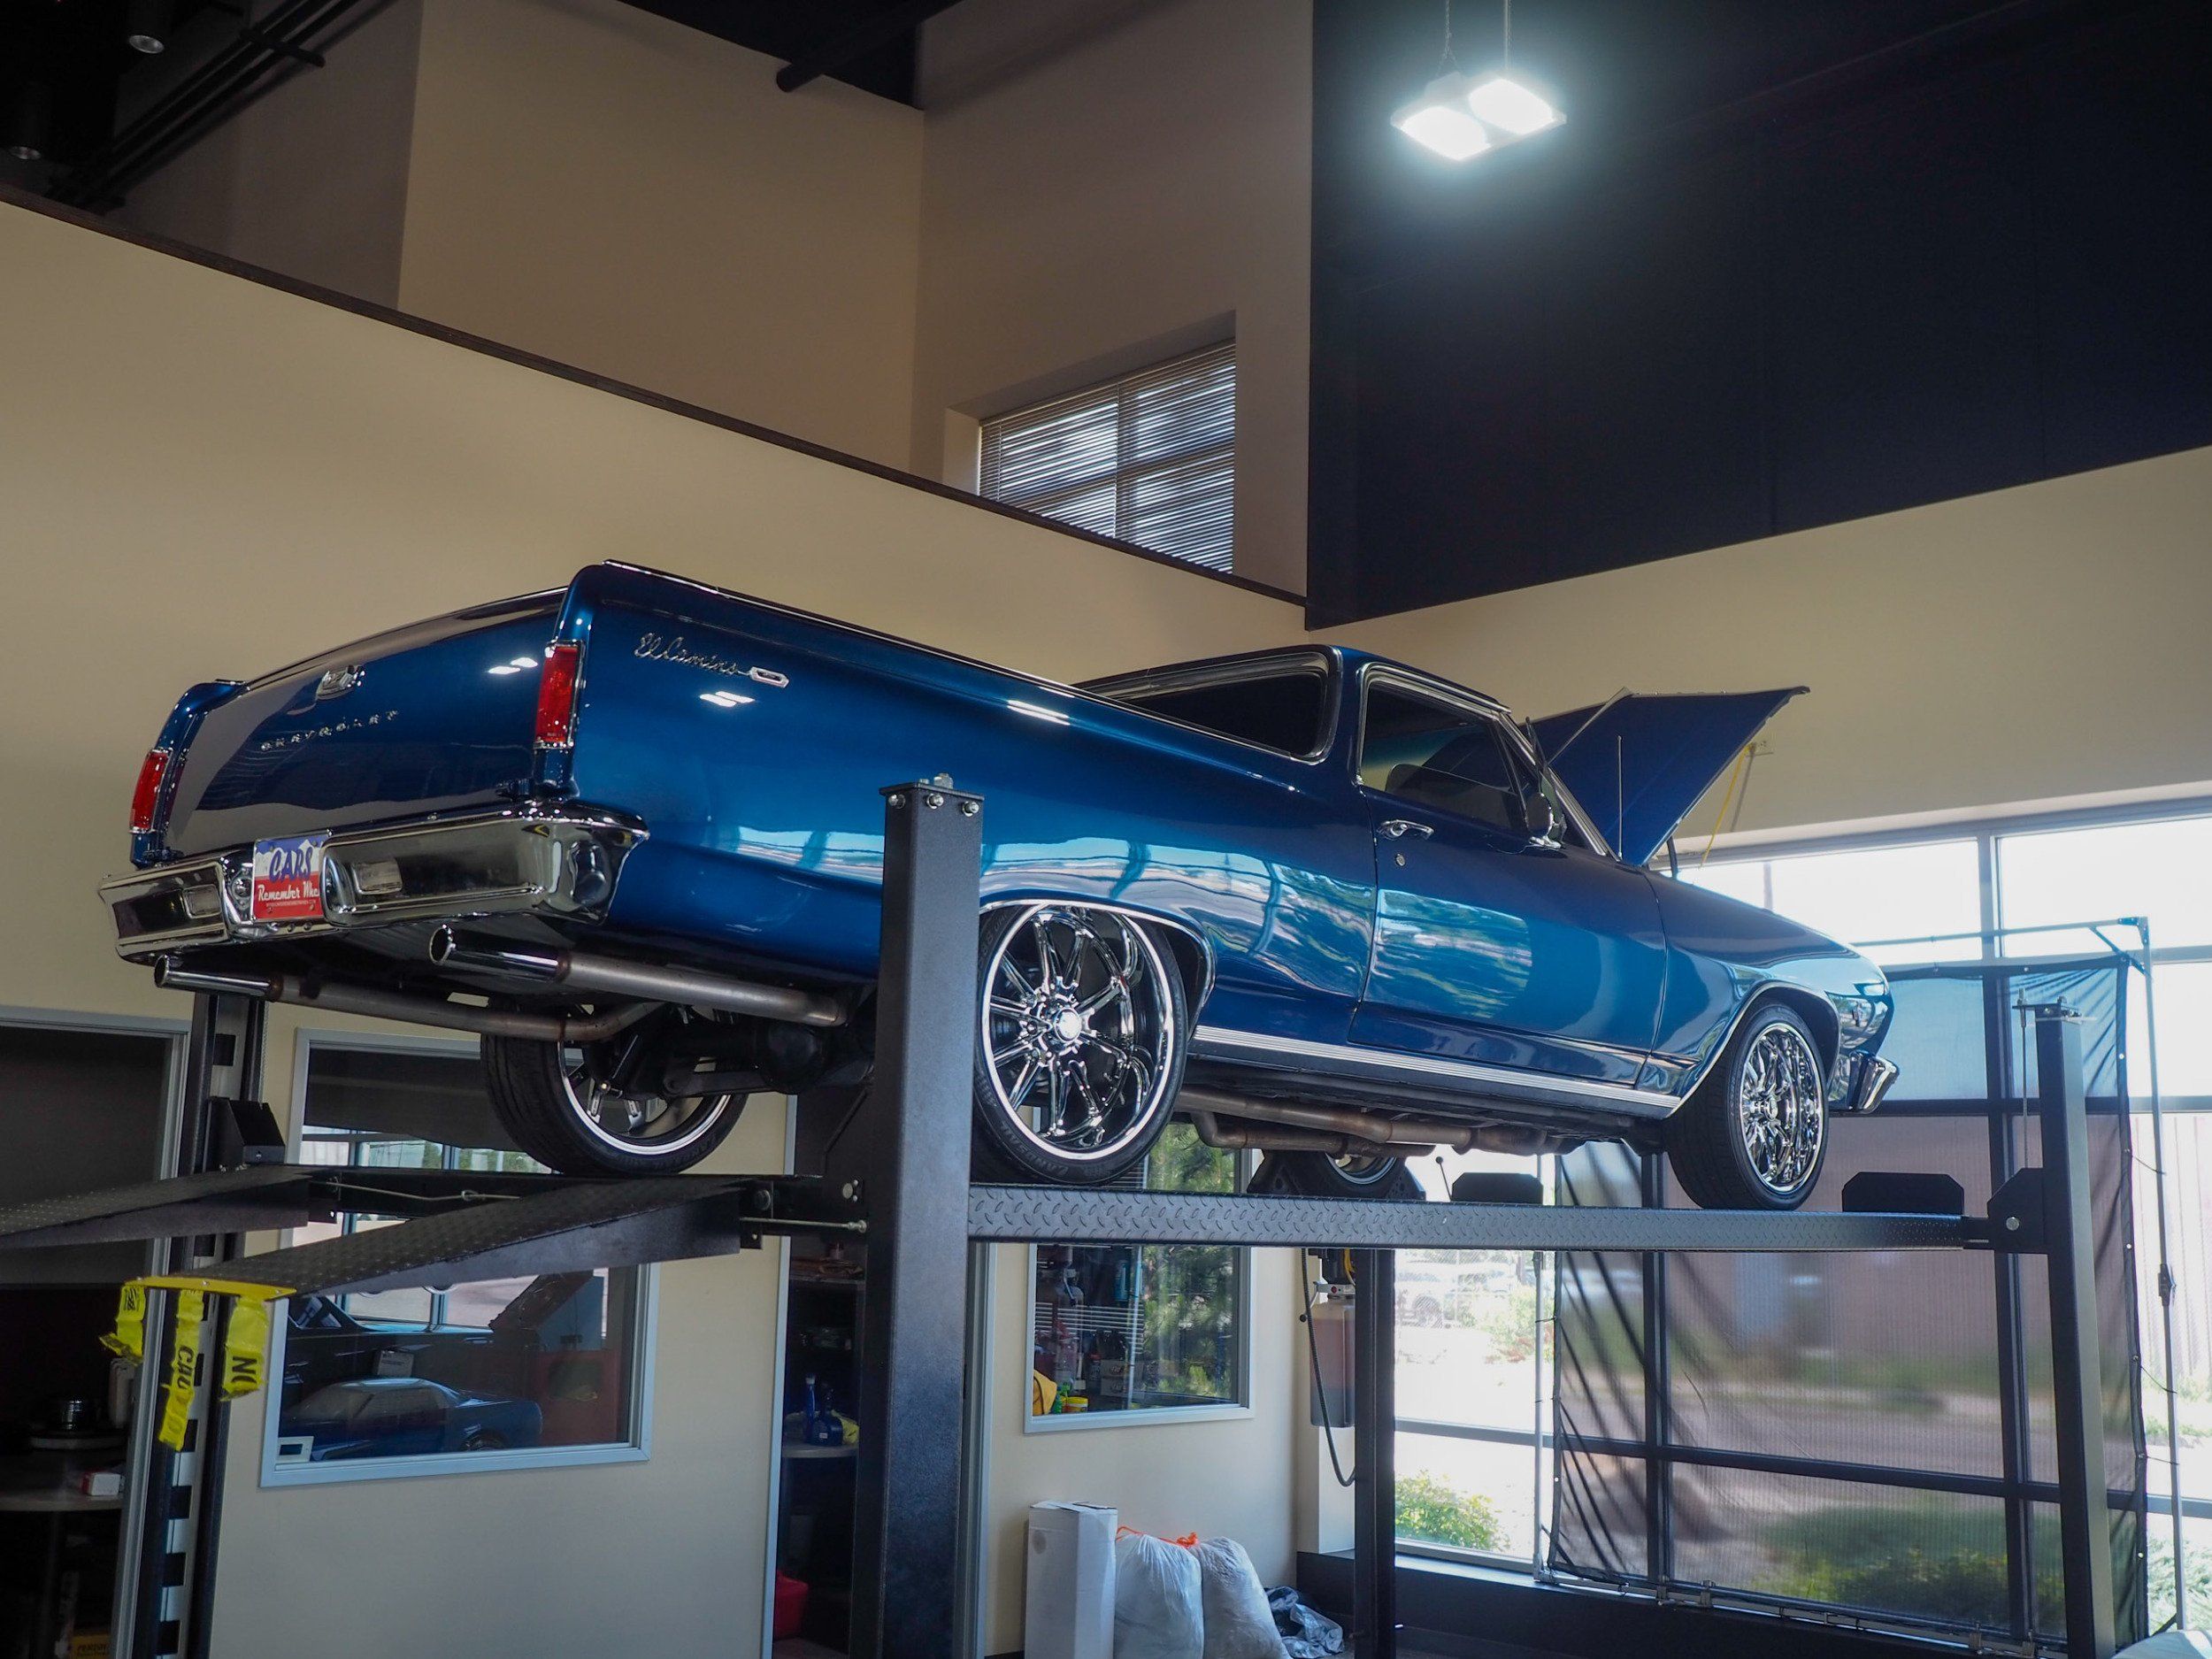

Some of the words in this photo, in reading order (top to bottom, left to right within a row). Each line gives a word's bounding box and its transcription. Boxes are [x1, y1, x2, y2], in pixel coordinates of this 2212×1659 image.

[269, 847, 314, 882] CARS
[257, 884, 301, 902] Remember
[303, 880, 320, 898] Whe
